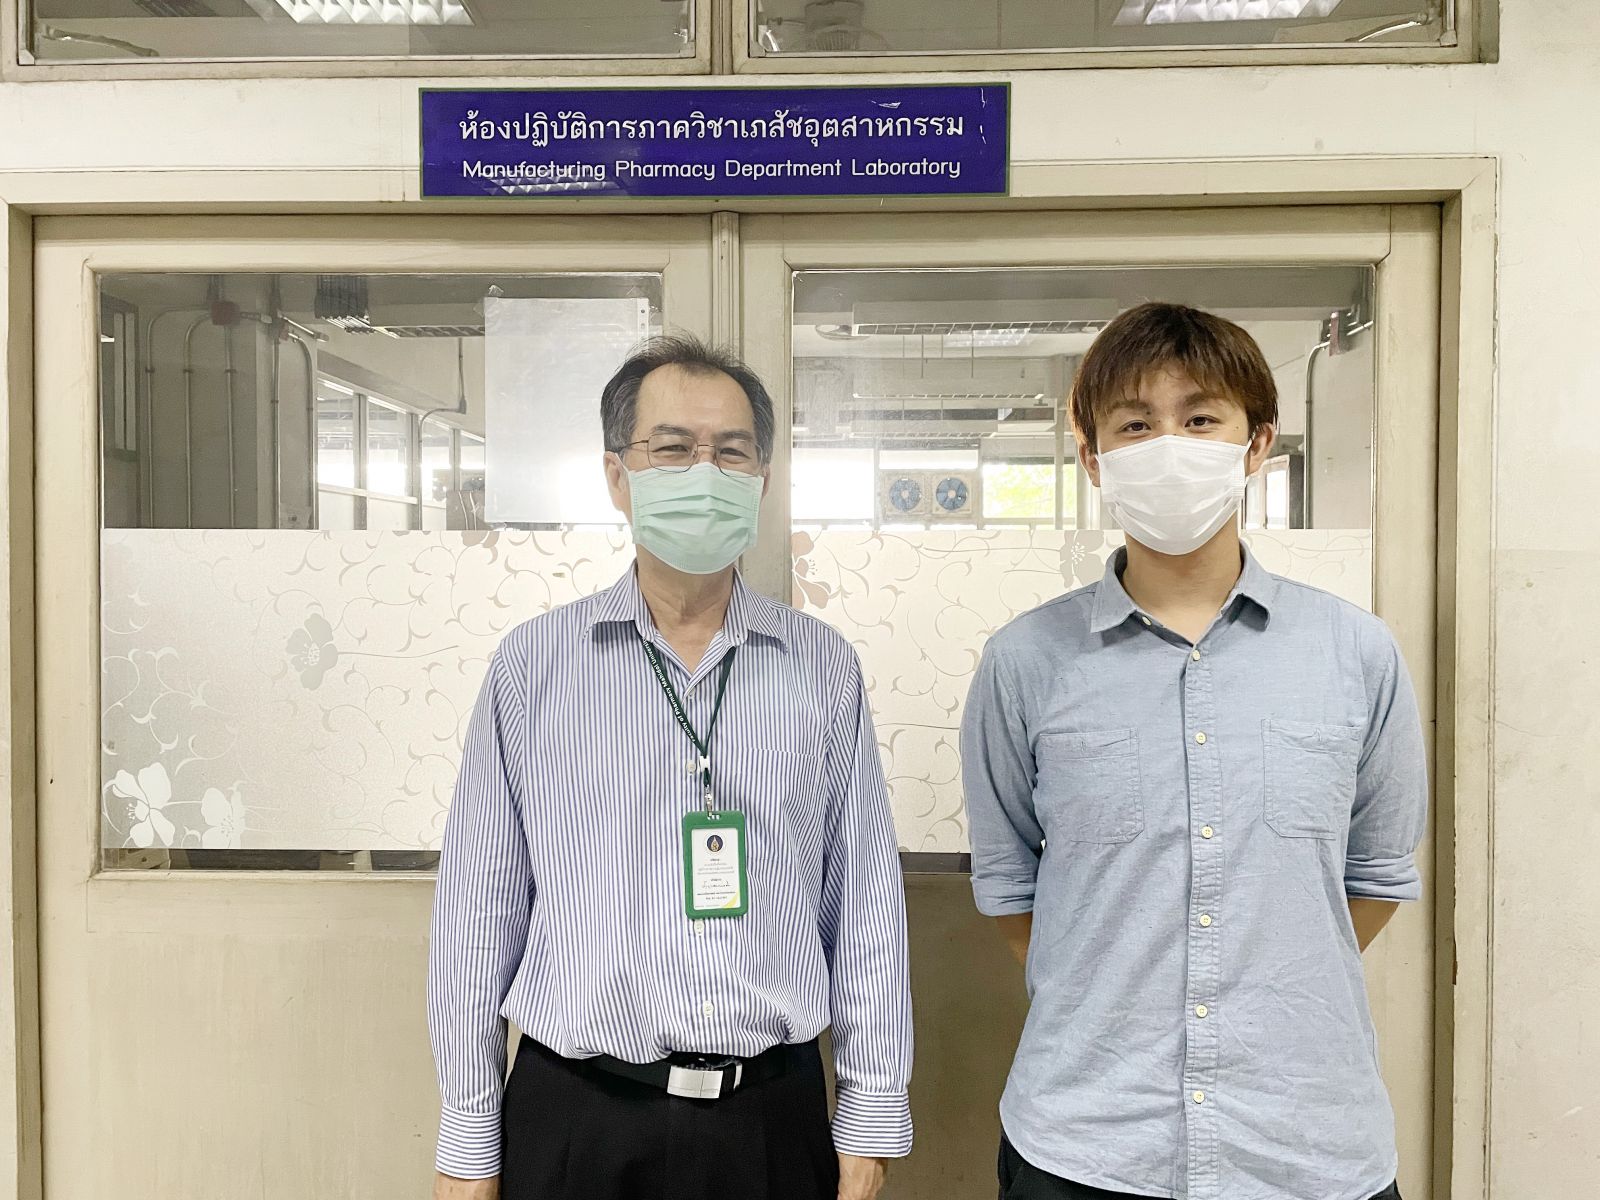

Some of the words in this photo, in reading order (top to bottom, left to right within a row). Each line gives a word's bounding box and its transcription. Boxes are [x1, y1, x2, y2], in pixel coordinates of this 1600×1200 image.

[459, 110, 964, 147] ห้องปฏิบัติการภาควิชาเภสัชอุตสาหกรรม
[463, 160, 606, 181] Manufacturing
[615, 160, 715, 180] Pharmacy
[725, 160, 842, 180] Department
[851, 158, 961, 178] Laboratory
[654, 664, 668, 688] Mahidol
[666, 687, 680, 715] Pharmacy
